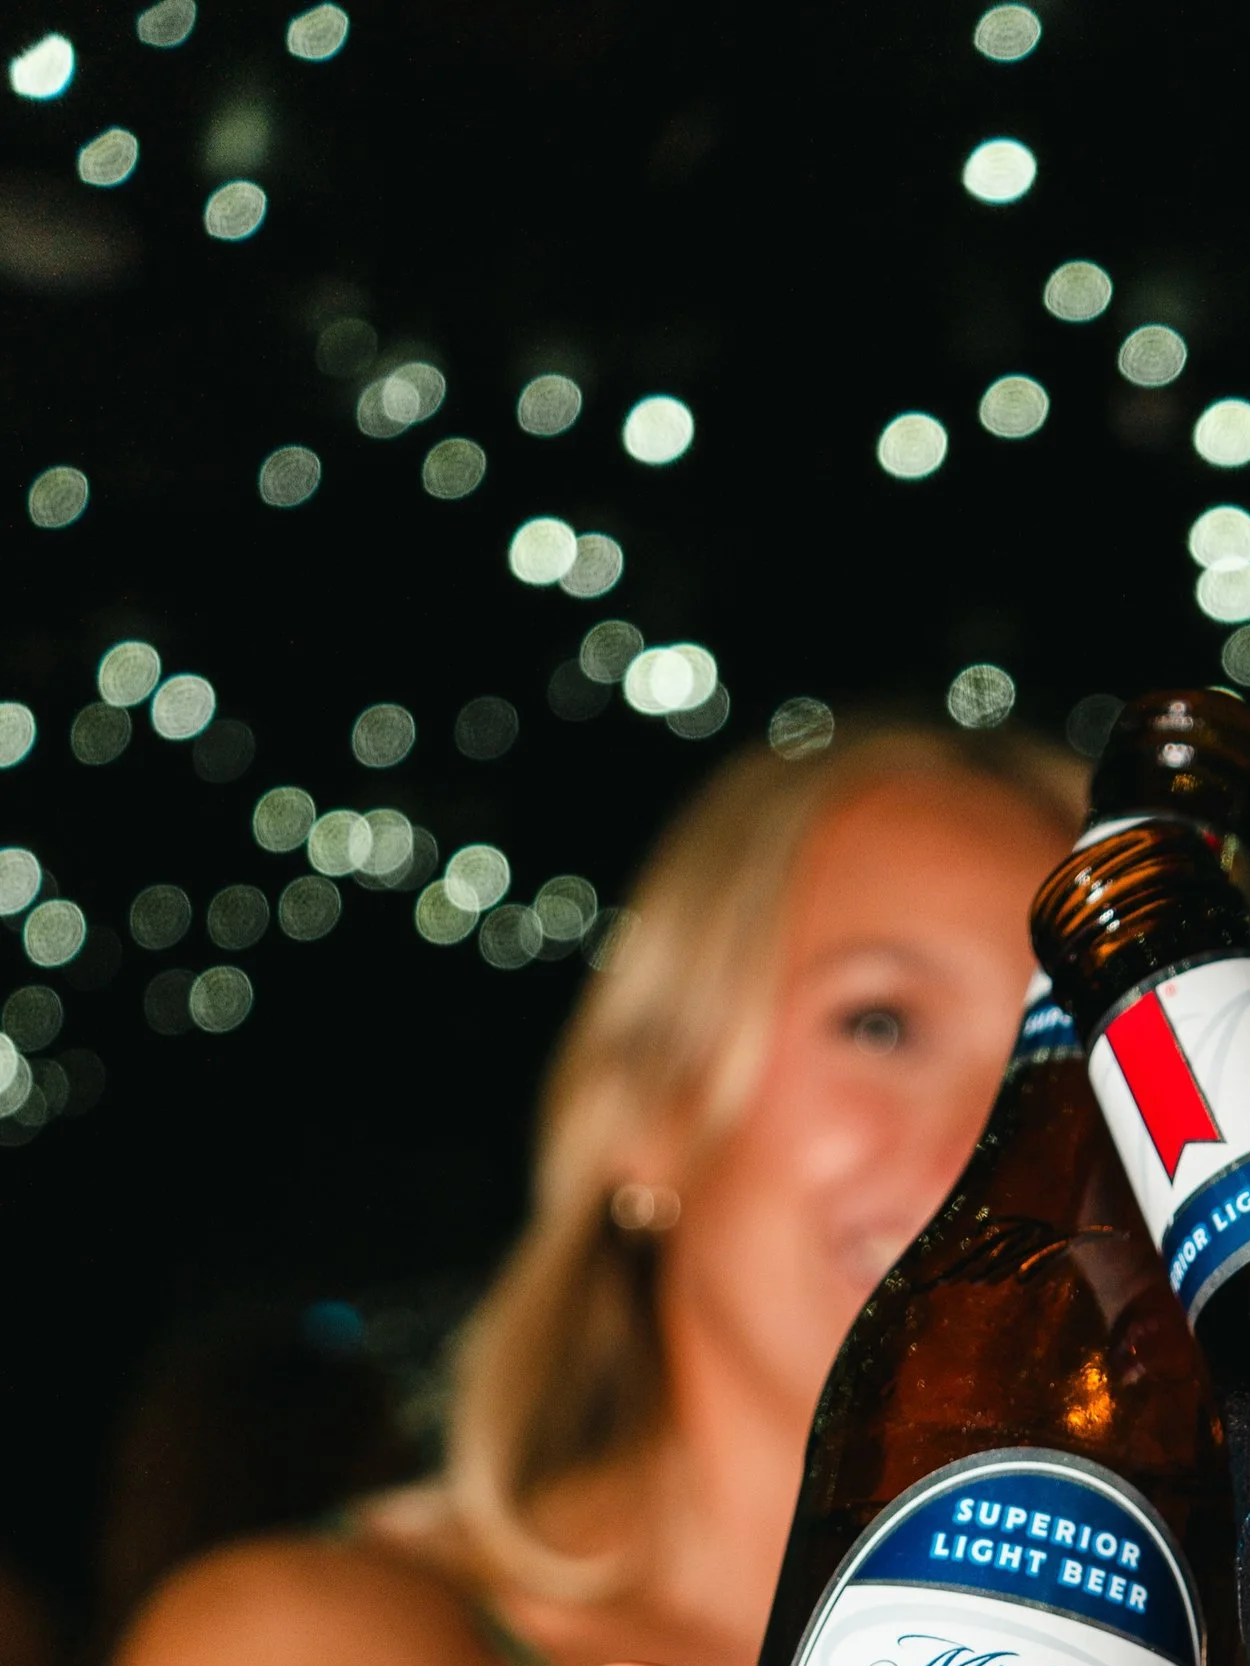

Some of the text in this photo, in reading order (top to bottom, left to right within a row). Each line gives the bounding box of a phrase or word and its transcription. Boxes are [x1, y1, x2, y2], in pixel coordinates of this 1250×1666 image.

[931, 1532, 1149, 1612] LIGHT BEER
[955, 1498, 1142, 1570] SUPERIOR
